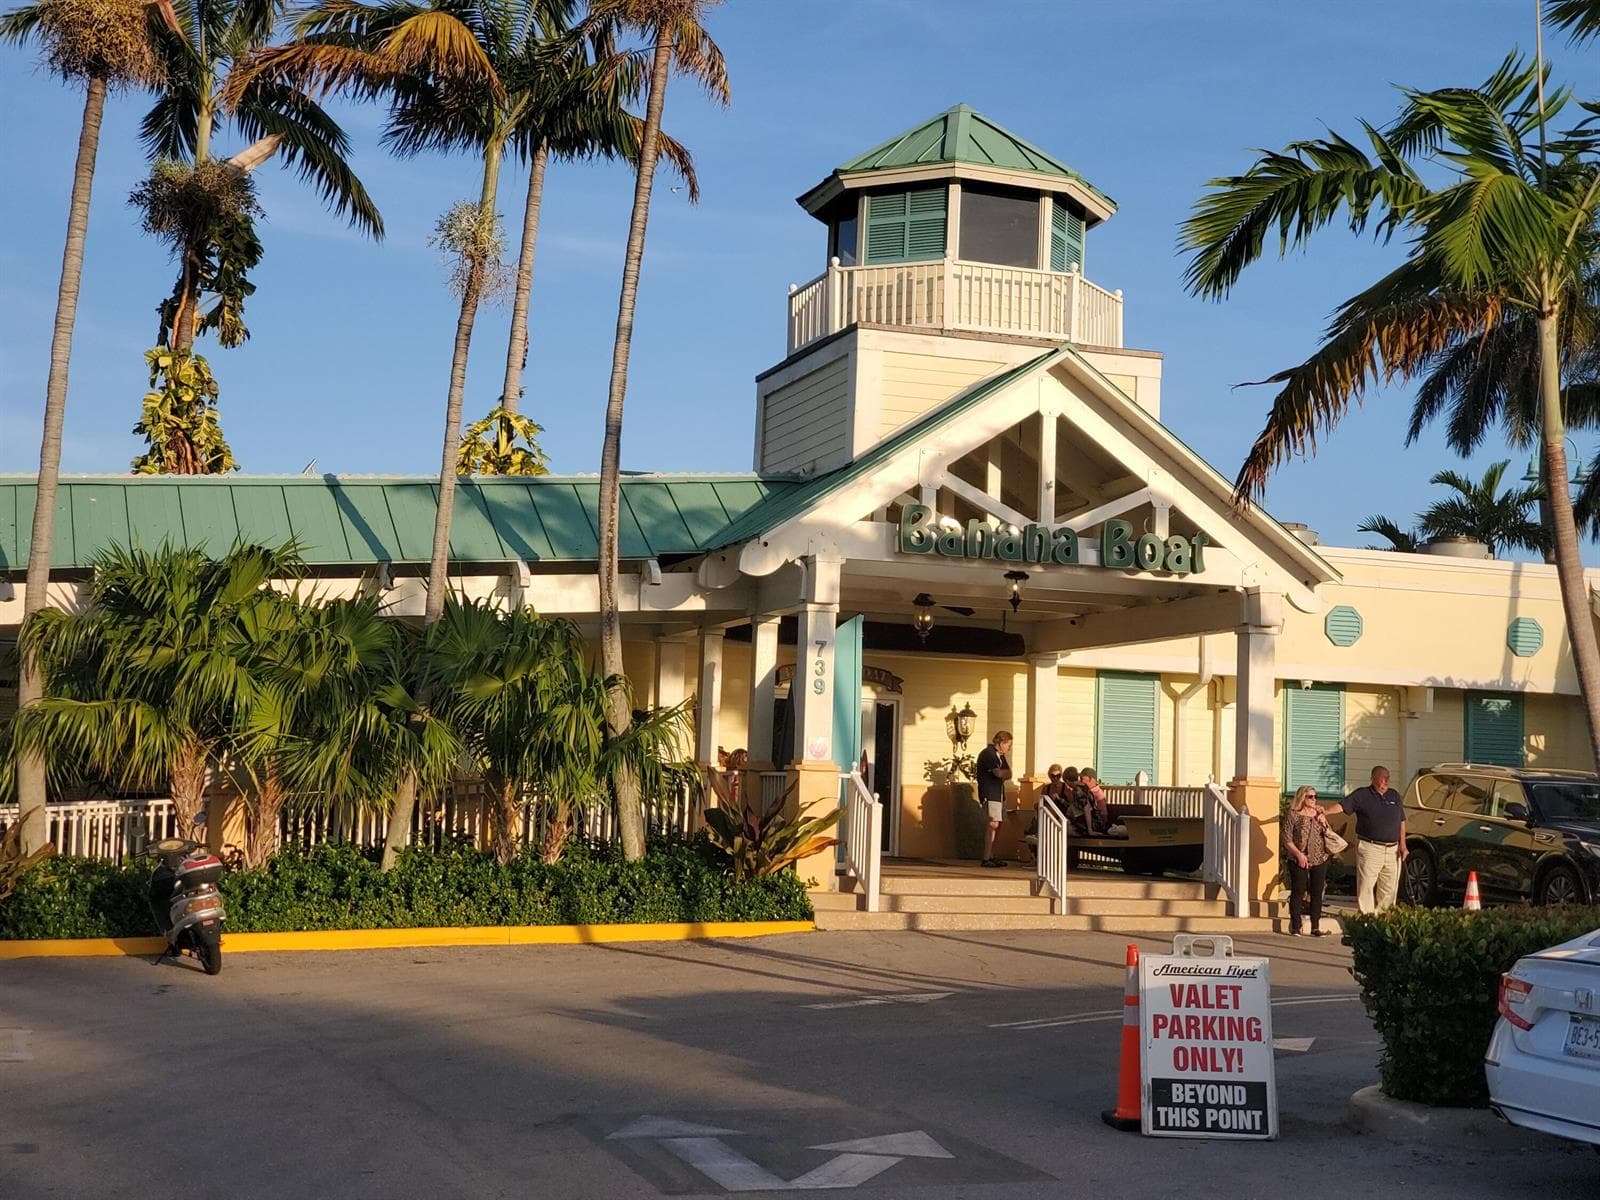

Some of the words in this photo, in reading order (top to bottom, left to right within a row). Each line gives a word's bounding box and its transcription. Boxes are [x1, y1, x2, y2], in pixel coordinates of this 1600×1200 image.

[900, 503, 1079, 565] Banana
[1101, 519, 1210, 575] Boat
[813, 640, 828, 695] 739
[1153, 963, 1221, 976] American
[1226, 965, 1258, 979] Flyer
[1169, 983, 1243, 1010] VALET
[1153, 1014, 1262, 1042] PARKING
[1173, 1046, 1244, 1073] ONLY!
[1171, 1083, 1247, 1106] BEYOND
[1157, 1106, 1200, 1128] THIS
[1205, 1108, 1263, 1130] POINT
